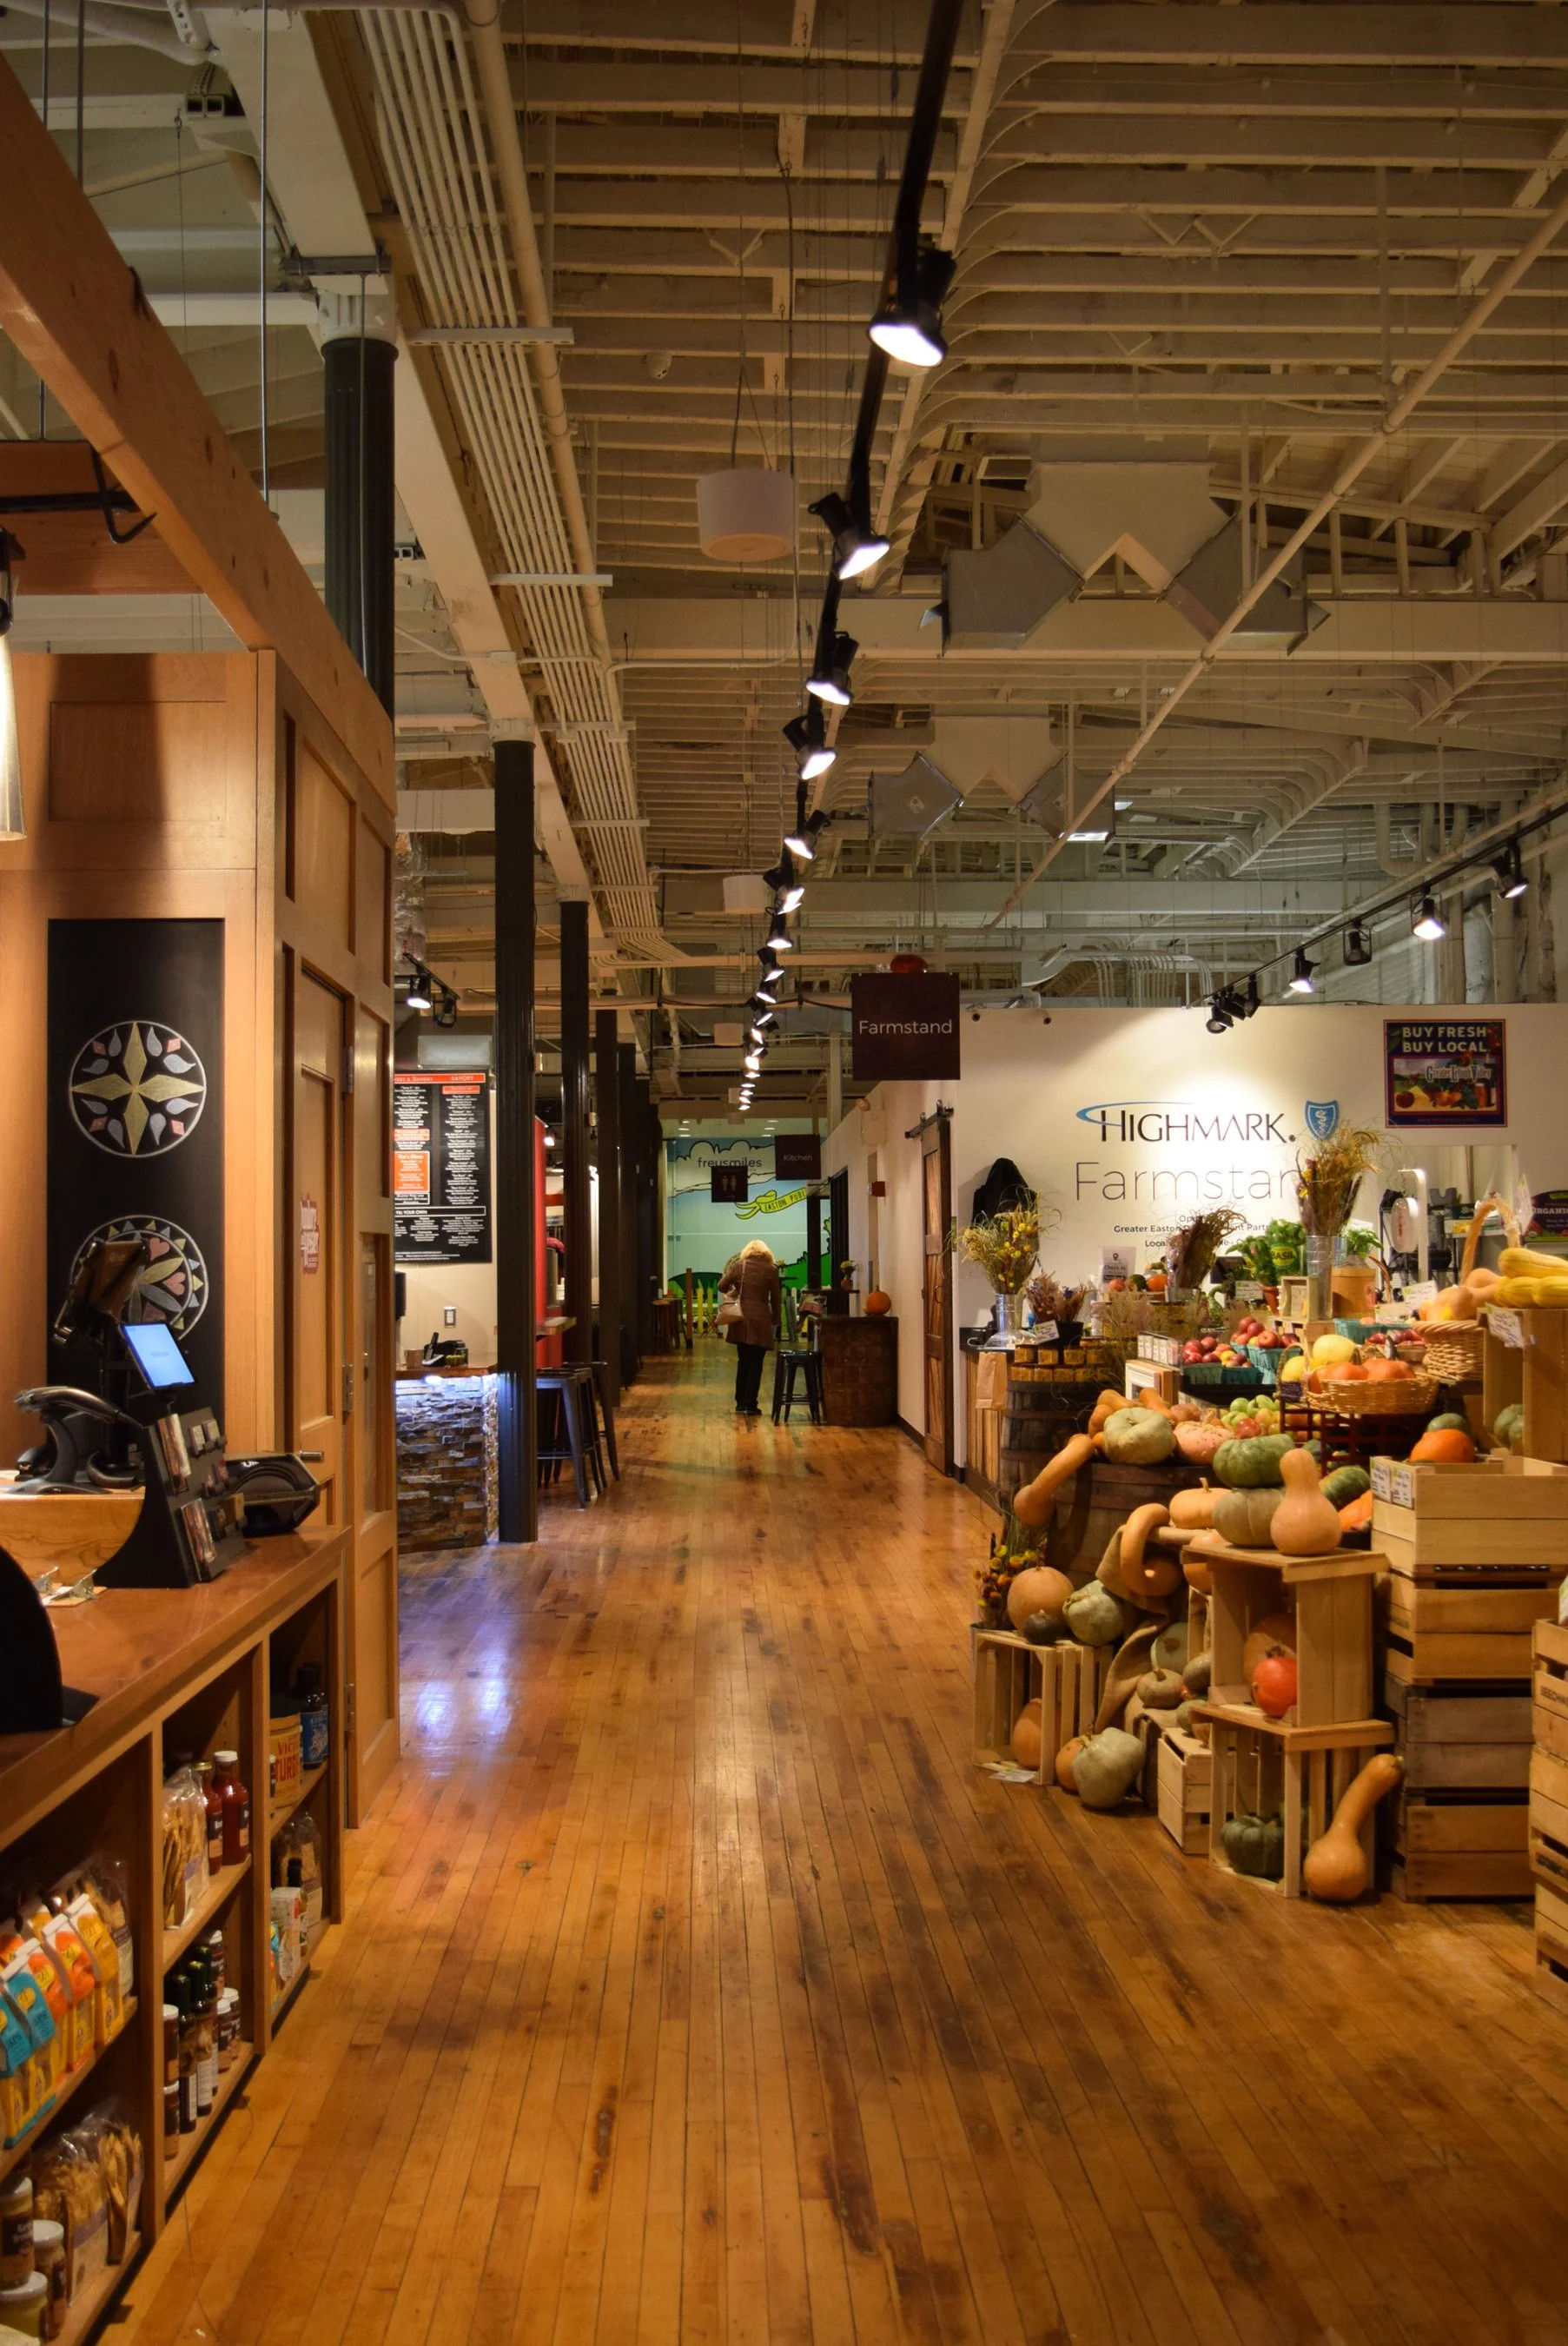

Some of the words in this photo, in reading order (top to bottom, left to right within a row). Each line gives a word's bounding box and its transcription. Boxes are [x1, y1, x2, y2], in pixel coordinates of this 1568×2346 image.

[859, 1018, 953, 1035] Farmstand
[1402, 1026, 1434, 1038] BUY
[1438, 1026, 1487, 1038] FRESH
[1402, 1041, 1434, 1053] BUY
[1438, 1041, 1488, 1053] LOCAL
[764, 1198, 787, 1211] EASTON
[1113, 1224, 1148, 1233] Greater
